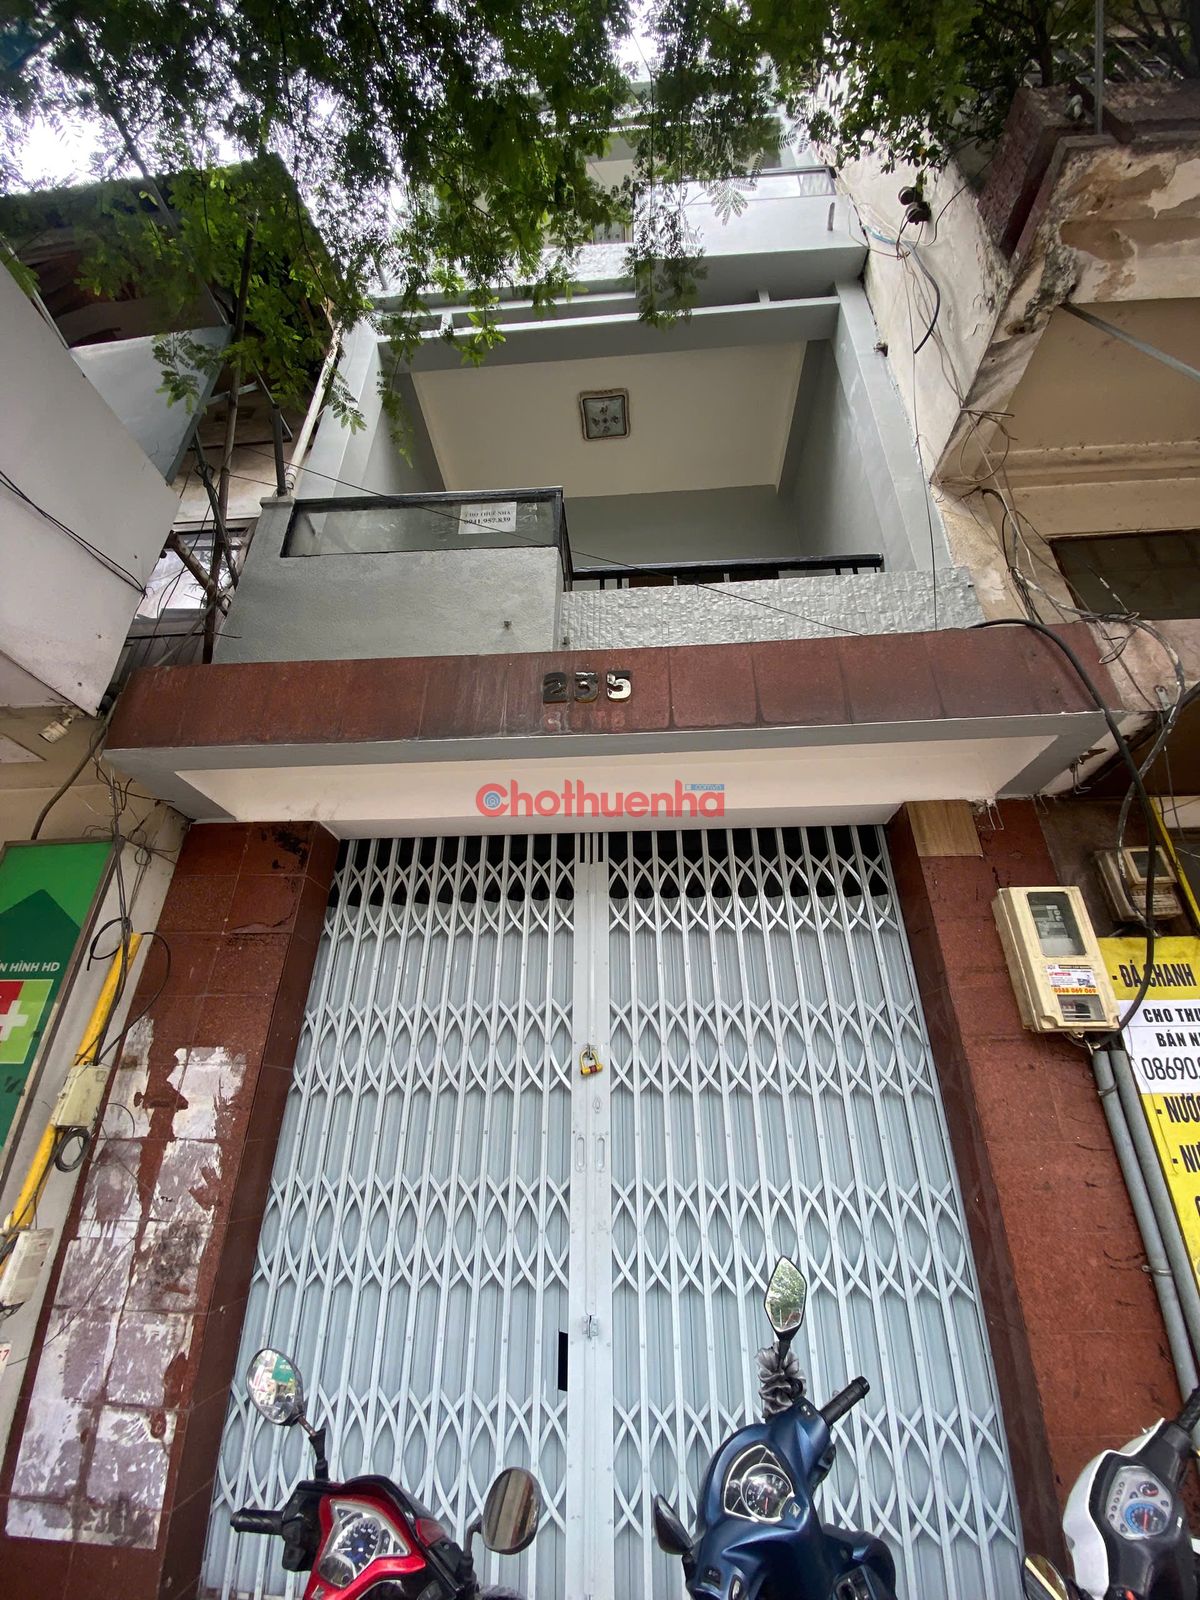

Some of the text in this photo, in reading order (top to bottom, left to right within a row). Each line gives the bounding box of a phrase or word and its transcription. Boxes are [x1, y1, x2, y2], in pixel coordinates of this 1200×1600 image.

[542, 670, 633, 704] 235
[9, 960, 40, 973] HÌNH
[41, 961, 61, 972] HD
[1143, 963, 1197, 987] CHANH
[1142, 1008, 1174, 1023] CHO
[1155, 1029, 1187, 1047] BÁN
